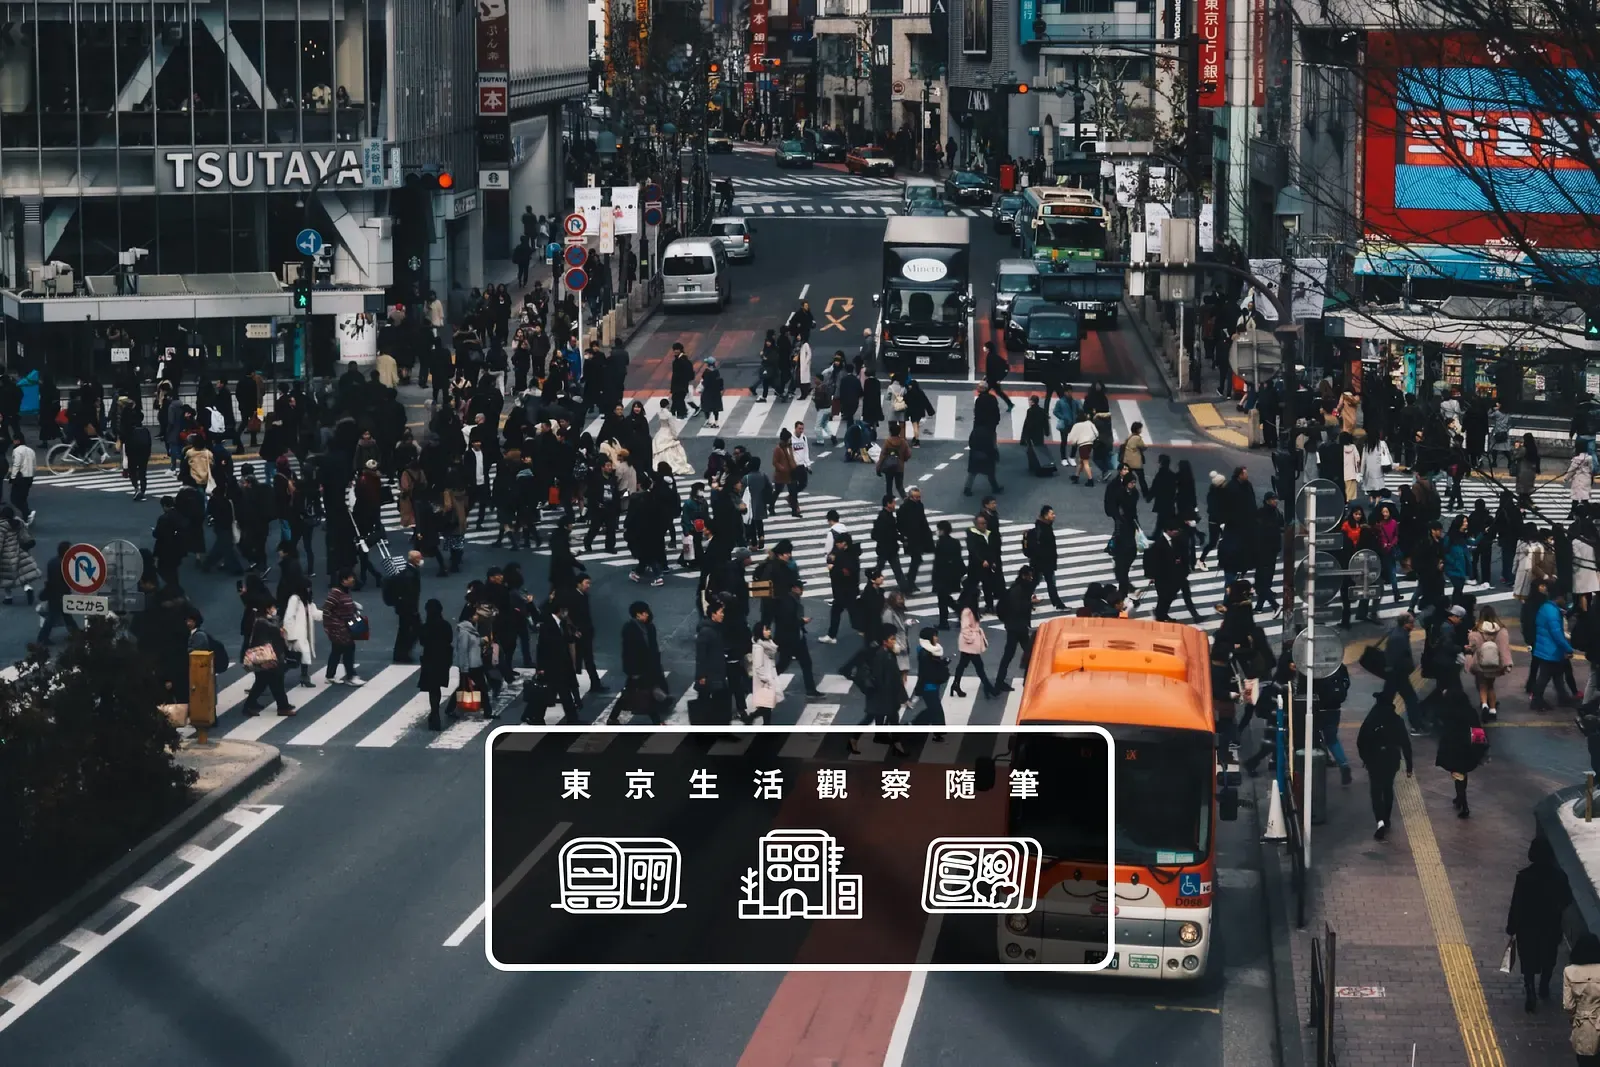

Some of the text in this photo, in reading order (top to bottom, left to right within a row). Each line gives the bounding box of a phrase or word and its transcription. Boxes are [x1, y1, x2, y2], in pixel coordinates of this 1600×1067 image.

[1204, 0, 1219, 84] 東京UFJ銀
[484, 90, 502, 109] 本
[968, 90, 990, 111] ZARA
[166, 150, 363, 188] TSUTAYA
[371, 142, 381, 185] 渋谷駅前
[907, 264, 945, 273] Minette
[66, 601, 105, 612] ここから
